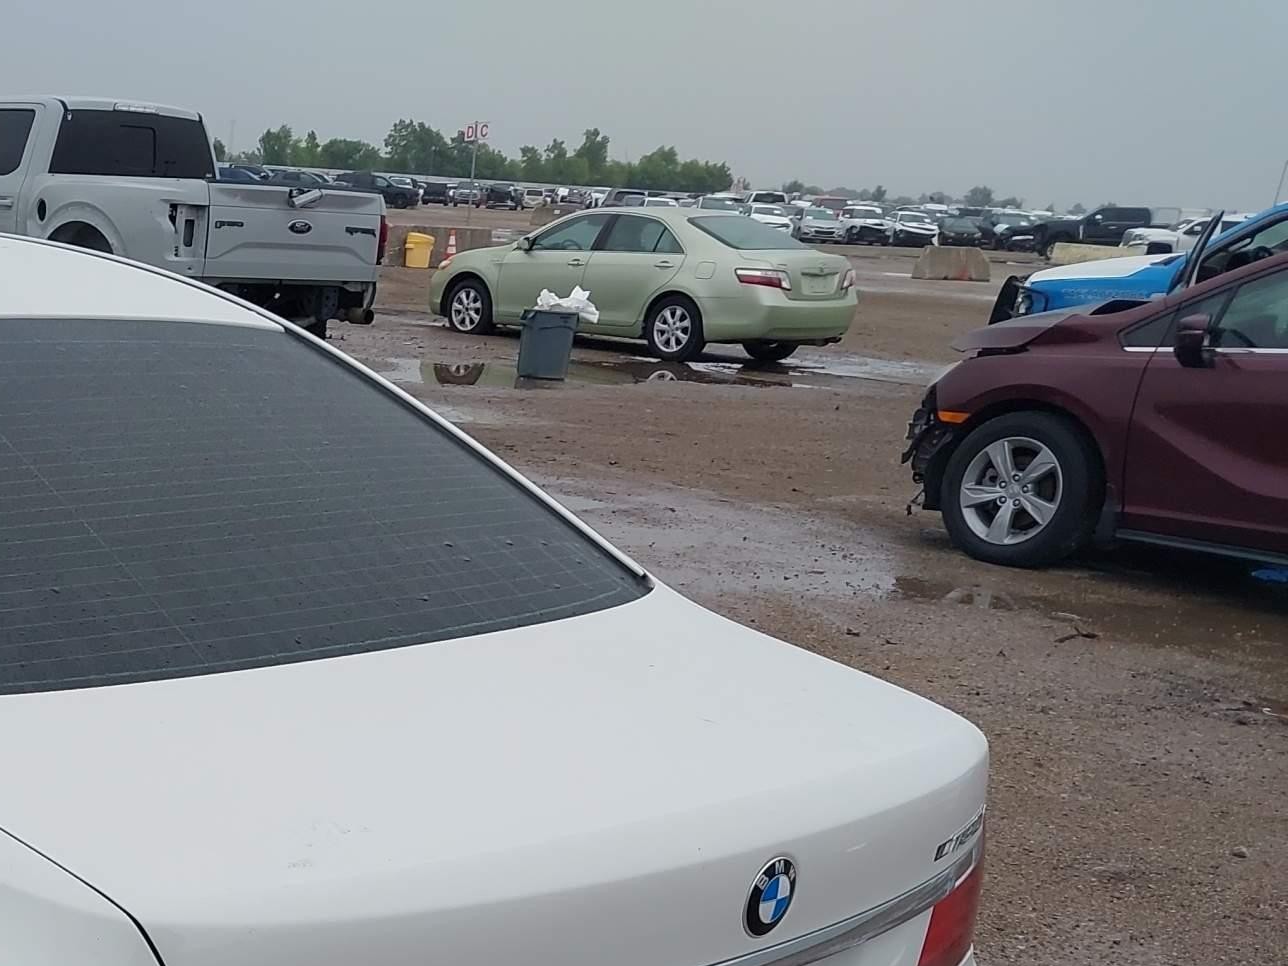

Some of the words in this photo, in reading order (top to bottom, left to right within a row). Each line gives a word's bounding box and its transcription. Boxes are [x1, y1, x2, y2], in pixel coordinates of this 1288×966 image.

[466, 125, 475, 139] D
[480, 124, 489, 138] C
[756, 859, 796, 890] BMW
